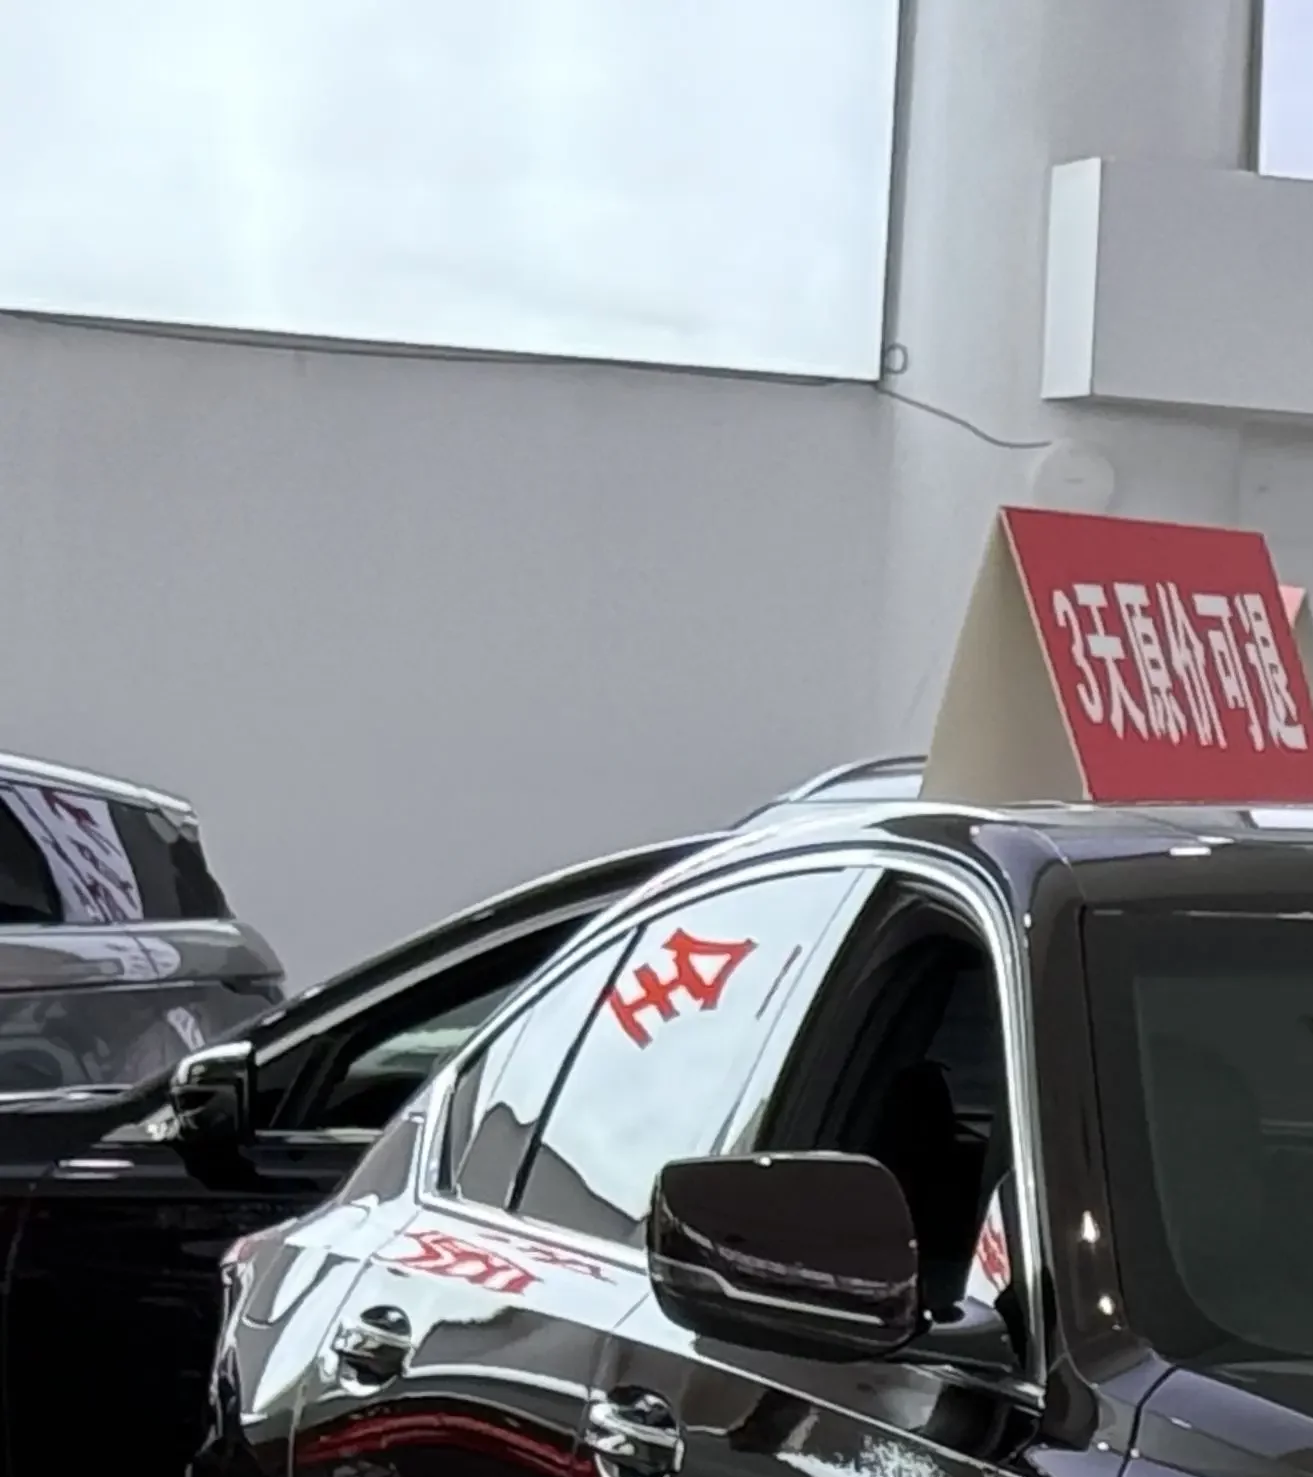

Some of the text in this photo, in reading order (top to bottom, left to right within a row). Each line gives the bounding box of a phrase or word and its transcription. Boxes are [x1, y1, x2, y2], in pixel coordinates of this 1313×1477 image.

[1053, 581, 1307, 751] 3天原价可退
